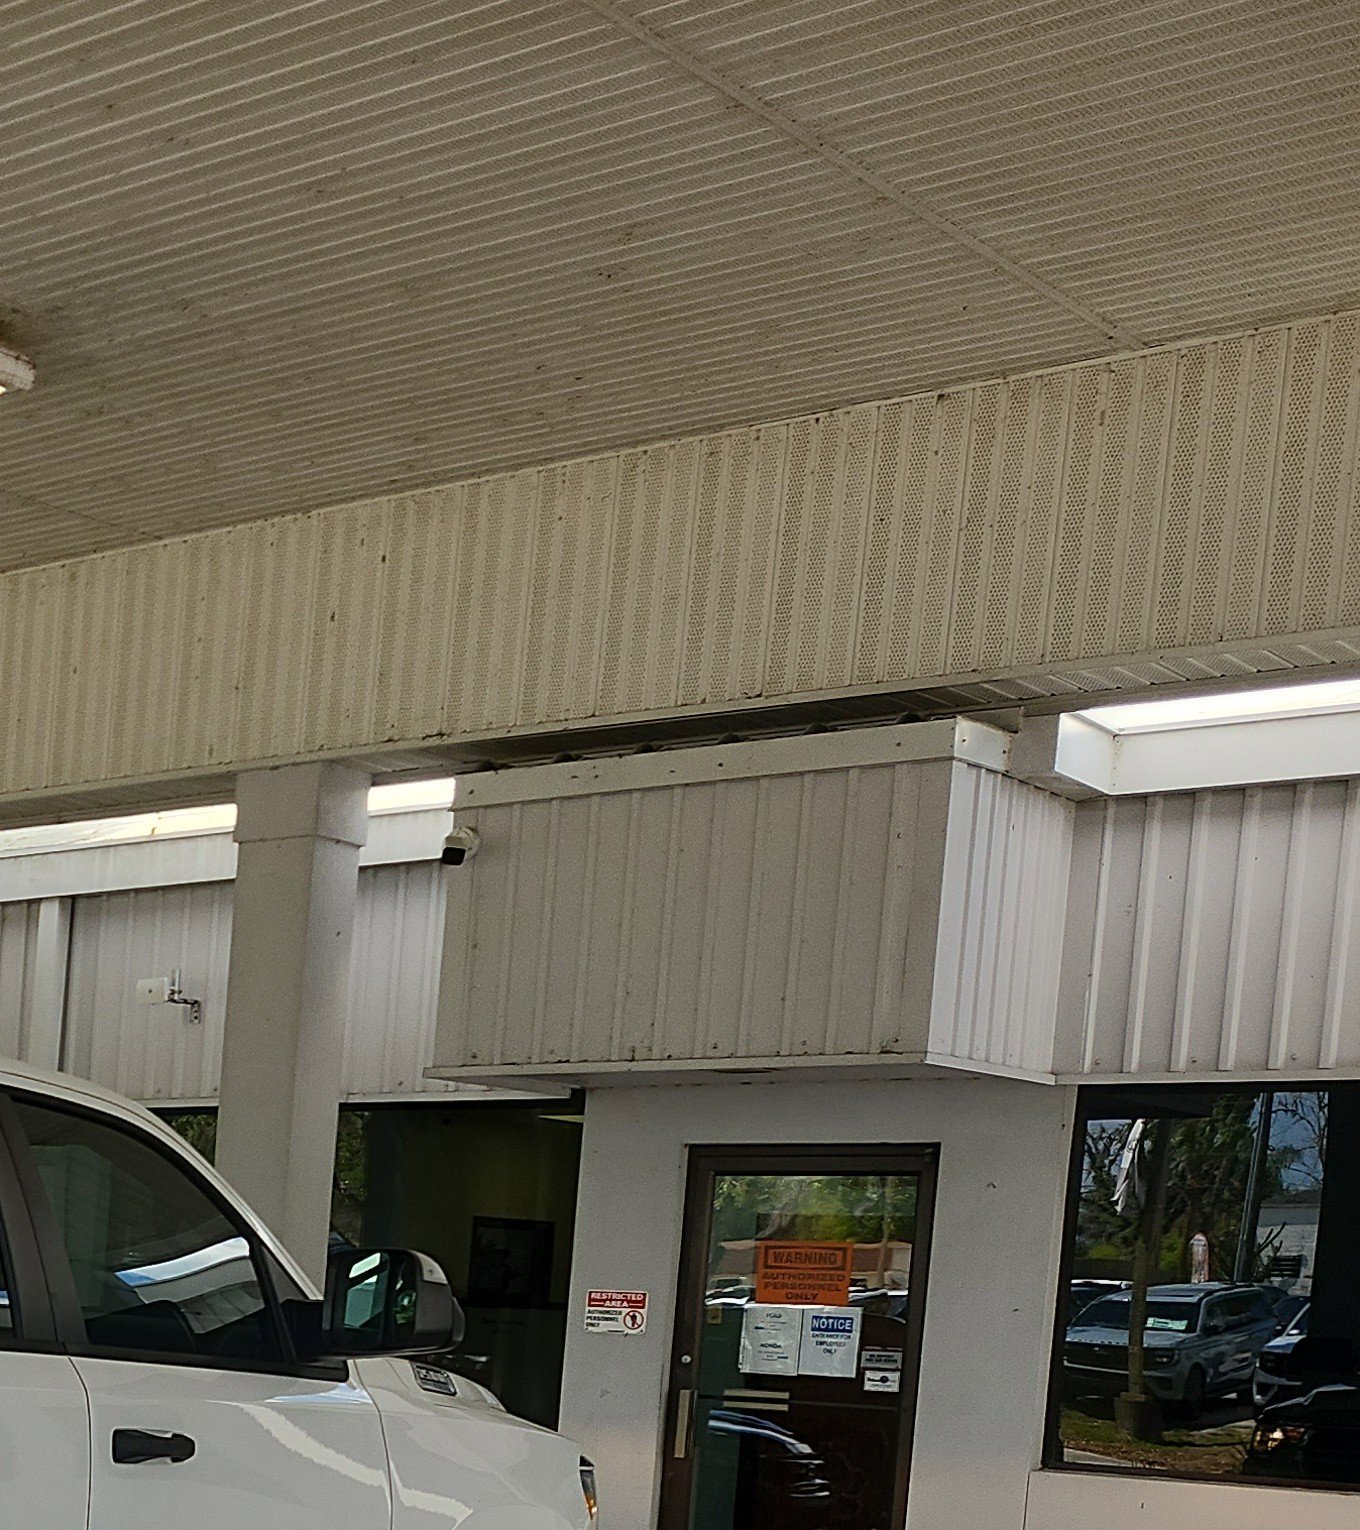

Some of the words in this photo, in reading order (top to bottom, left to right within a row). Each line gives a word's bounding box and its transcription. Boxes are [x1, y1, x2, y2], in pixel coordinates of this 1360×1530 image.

[772, 1250, 838, 1265] WARNING
[762, 1271, 846, 1282] AUTHORIZED
[763, 1281, 842, 1292] PERSONNEL
[590, 1292, 644, 1301] RESTRICTED
[785, 1291, 819, 1301] ONLY
[603, 1300, 629, 1308] AREA
[811, 1317, 853, 1330] NOTICE
